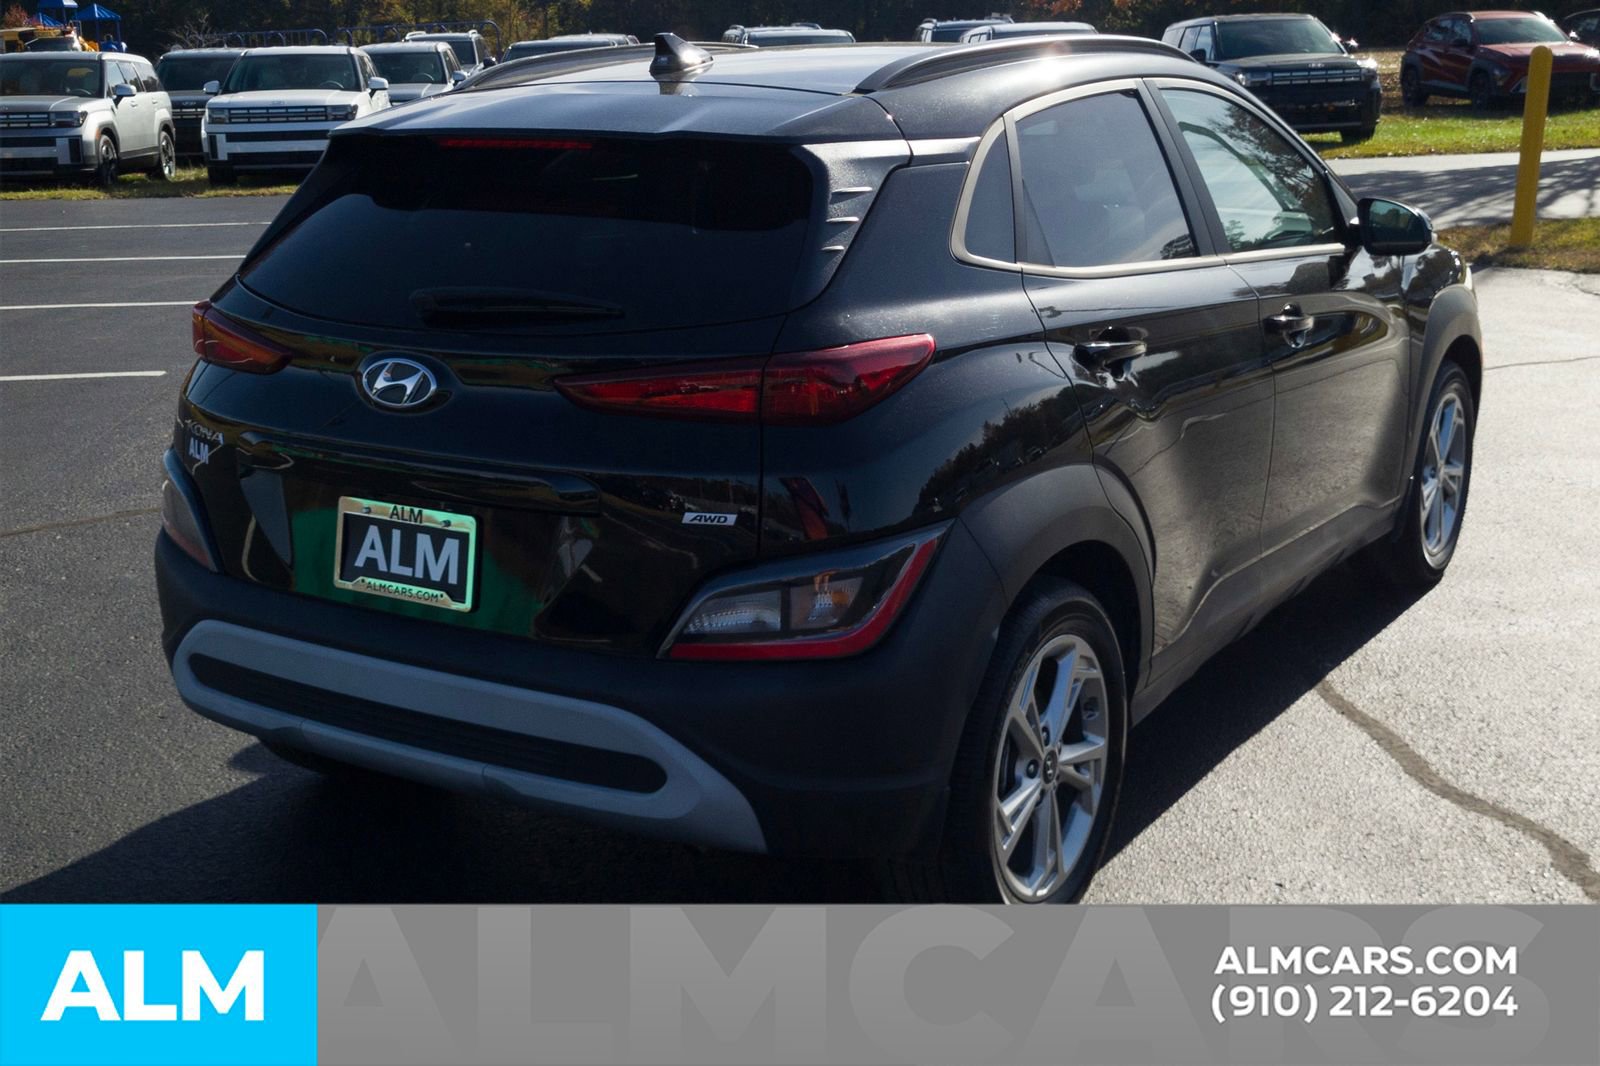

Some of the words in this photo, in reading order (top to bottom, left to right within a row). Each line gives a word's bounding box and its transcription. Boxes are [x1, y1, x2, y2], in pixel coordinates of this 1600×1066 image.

[189, 436, 209, 465] ALM
[389, 504, 424, 524] ALM
[689, 514, 728, 524] AWD
[353, 524, 460, 585] ALM
[365, 580, 439, 603] ALMCARS.COM
